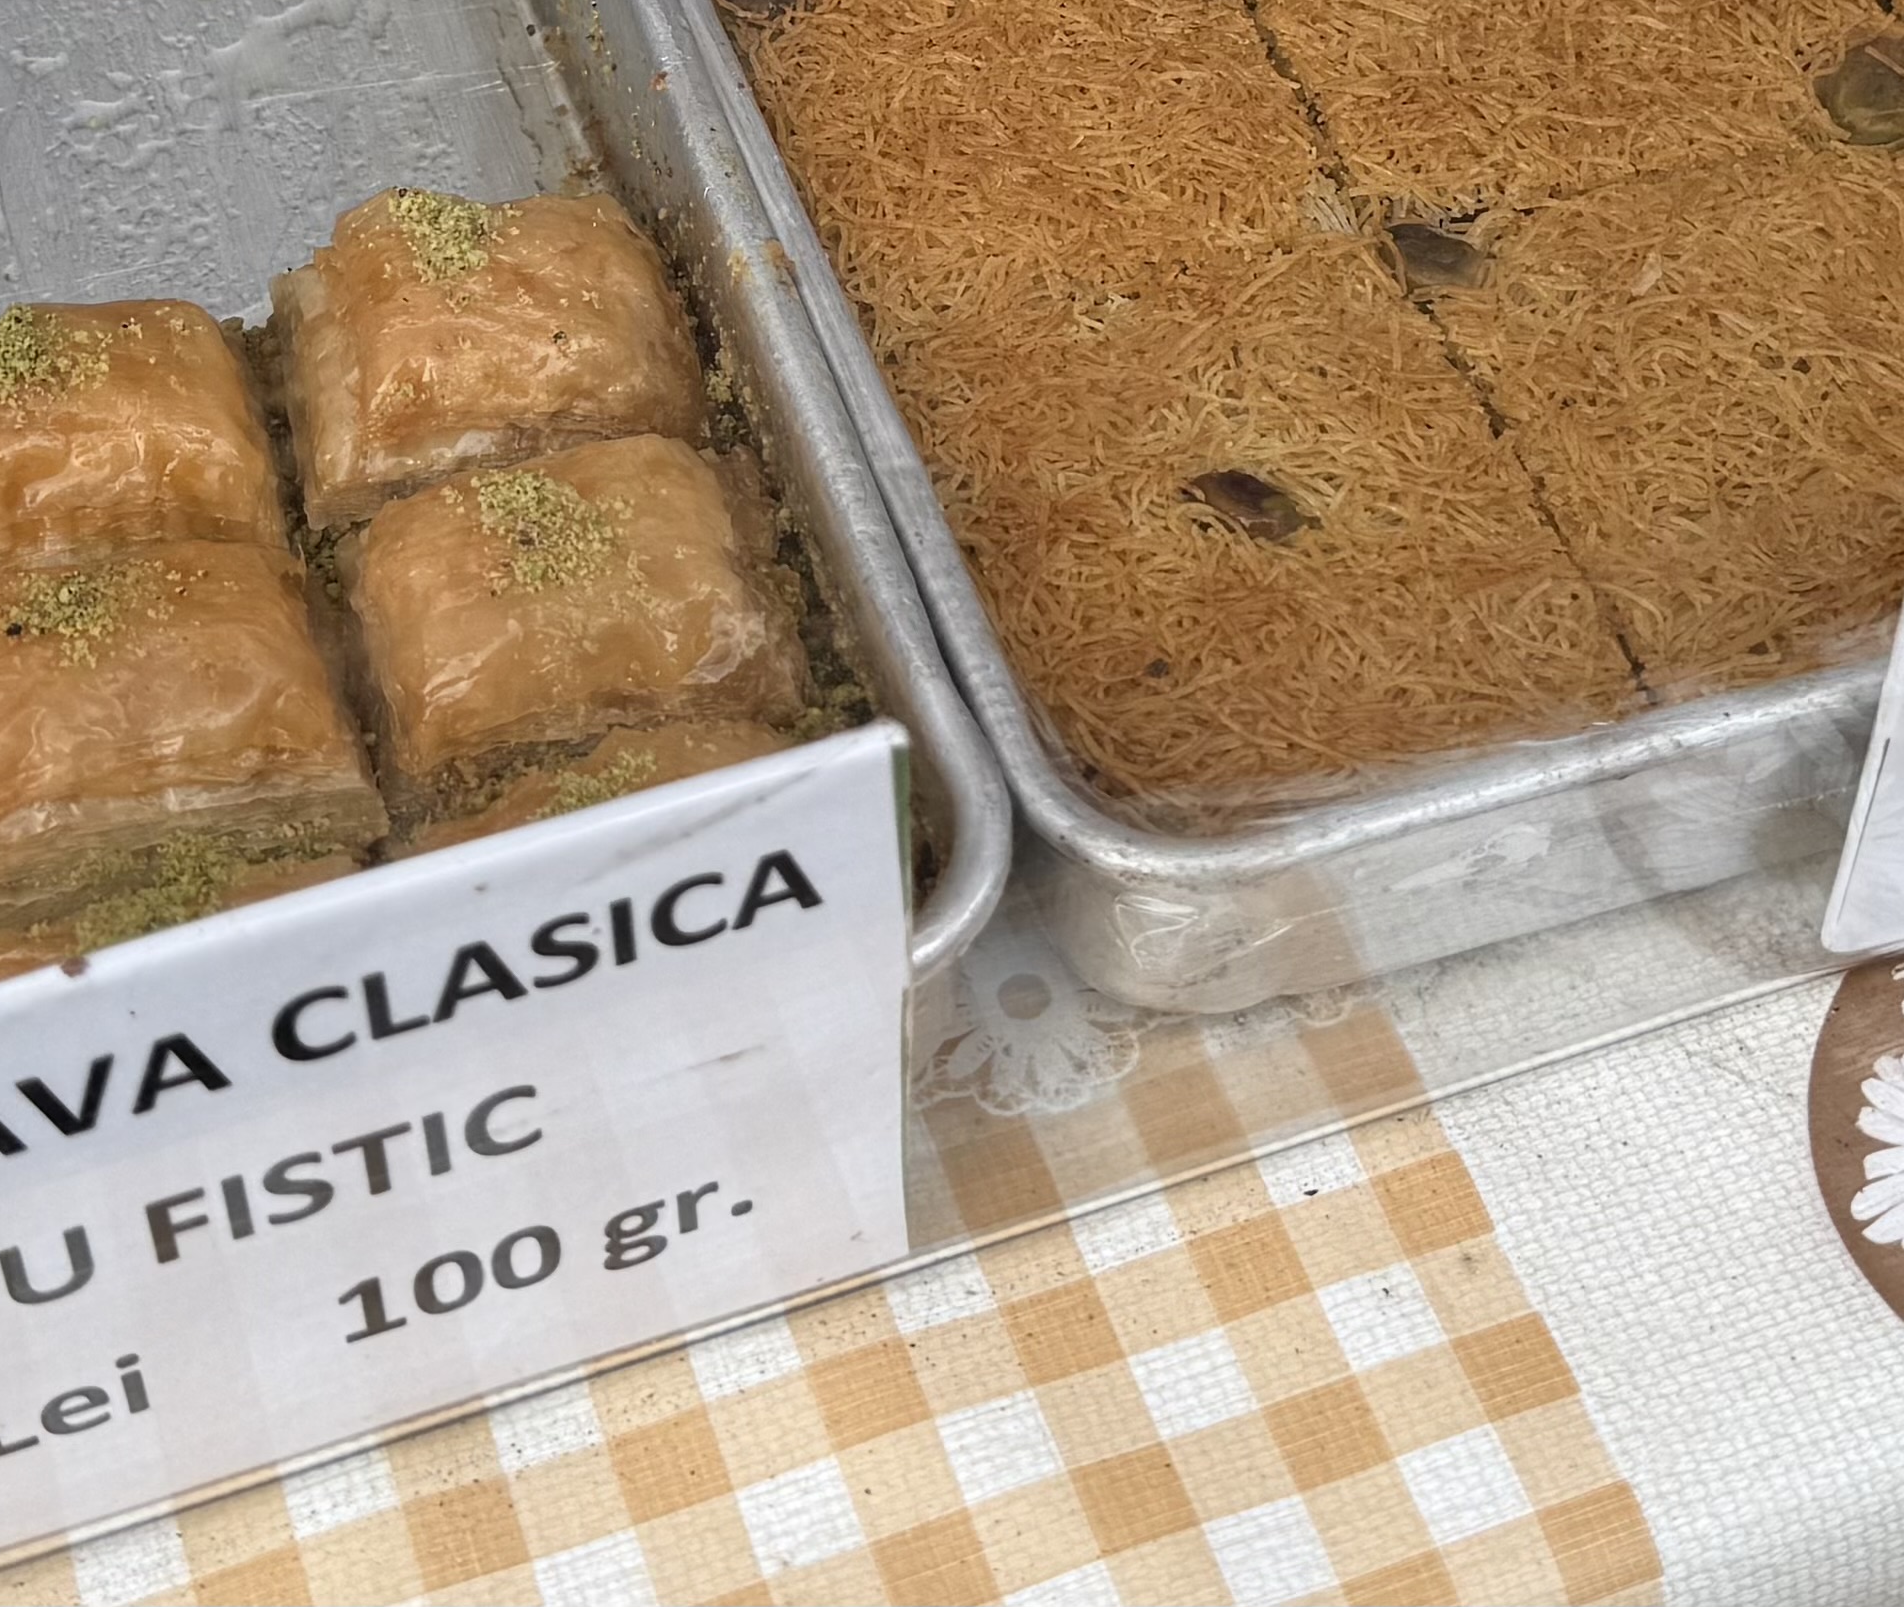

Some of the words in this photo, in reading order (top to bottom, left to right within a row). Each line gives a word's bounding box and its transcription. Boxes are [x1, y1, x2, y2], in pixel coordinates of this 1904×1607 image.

[270, 848, 824, 1064] CLASICA
[144, 1084, 543, 1265] FISTIC
[337, 1224, 562, 1344] 100
[603, 1181, 754, 1272] gr.
